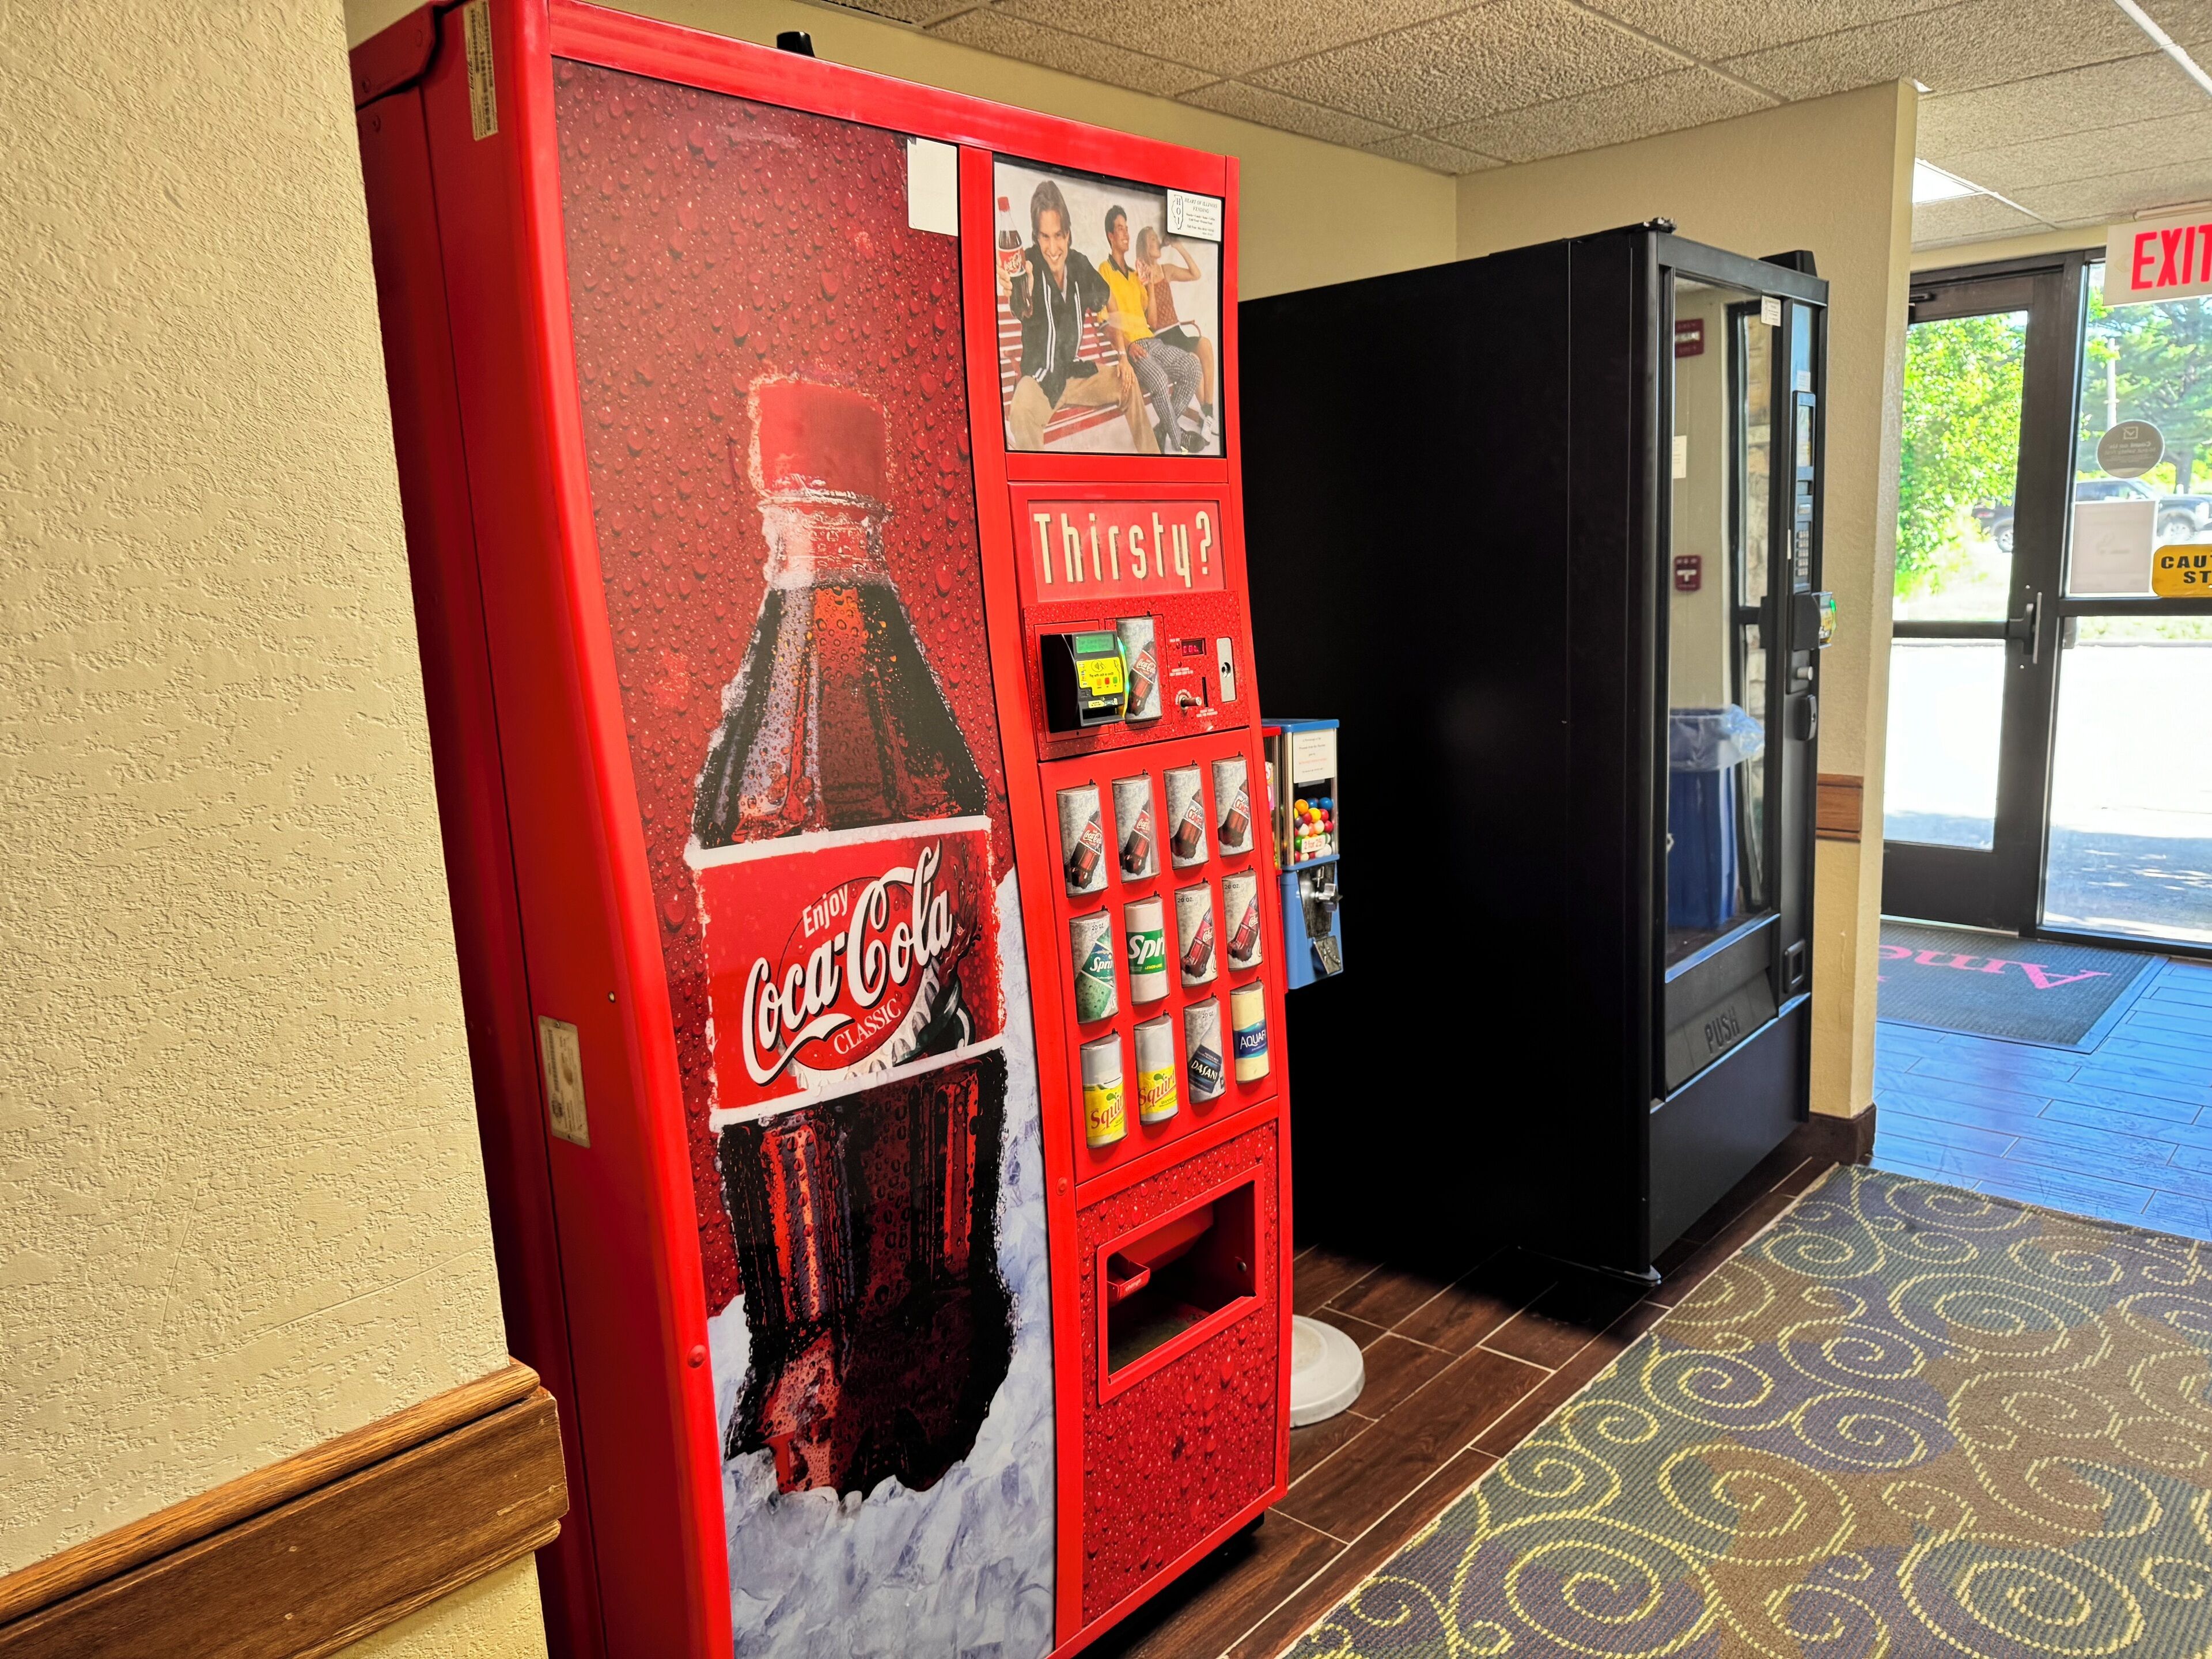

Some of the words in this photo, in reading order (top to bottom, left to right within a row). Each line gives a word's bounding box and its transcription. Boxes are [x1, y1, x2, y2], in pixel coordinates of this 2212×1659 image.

[2131, 223, 2212, 290] EXIT
[1033, 510, 1213, 588] Thirsty?
[2160, 555, 2212, 569] CAU
[2183, 570, 2212, 584] ST
[802, 884, 848, 938] Enjoy
[743, 838, 953, 1085] Coca-Cola
[1089, 955, 1112, 973] Spri
[1878, 944, 2112, 990] Ame
[834, 999, 902, 1055] CLASSIC
[1240, 1029, 1266, 1050] AQUAF
[1703, 1005, 1740, 1054] PUSH
[1191, 1059, 1218, 1081] DASANI
[1090, 1094, 1122, 1130] Squir
